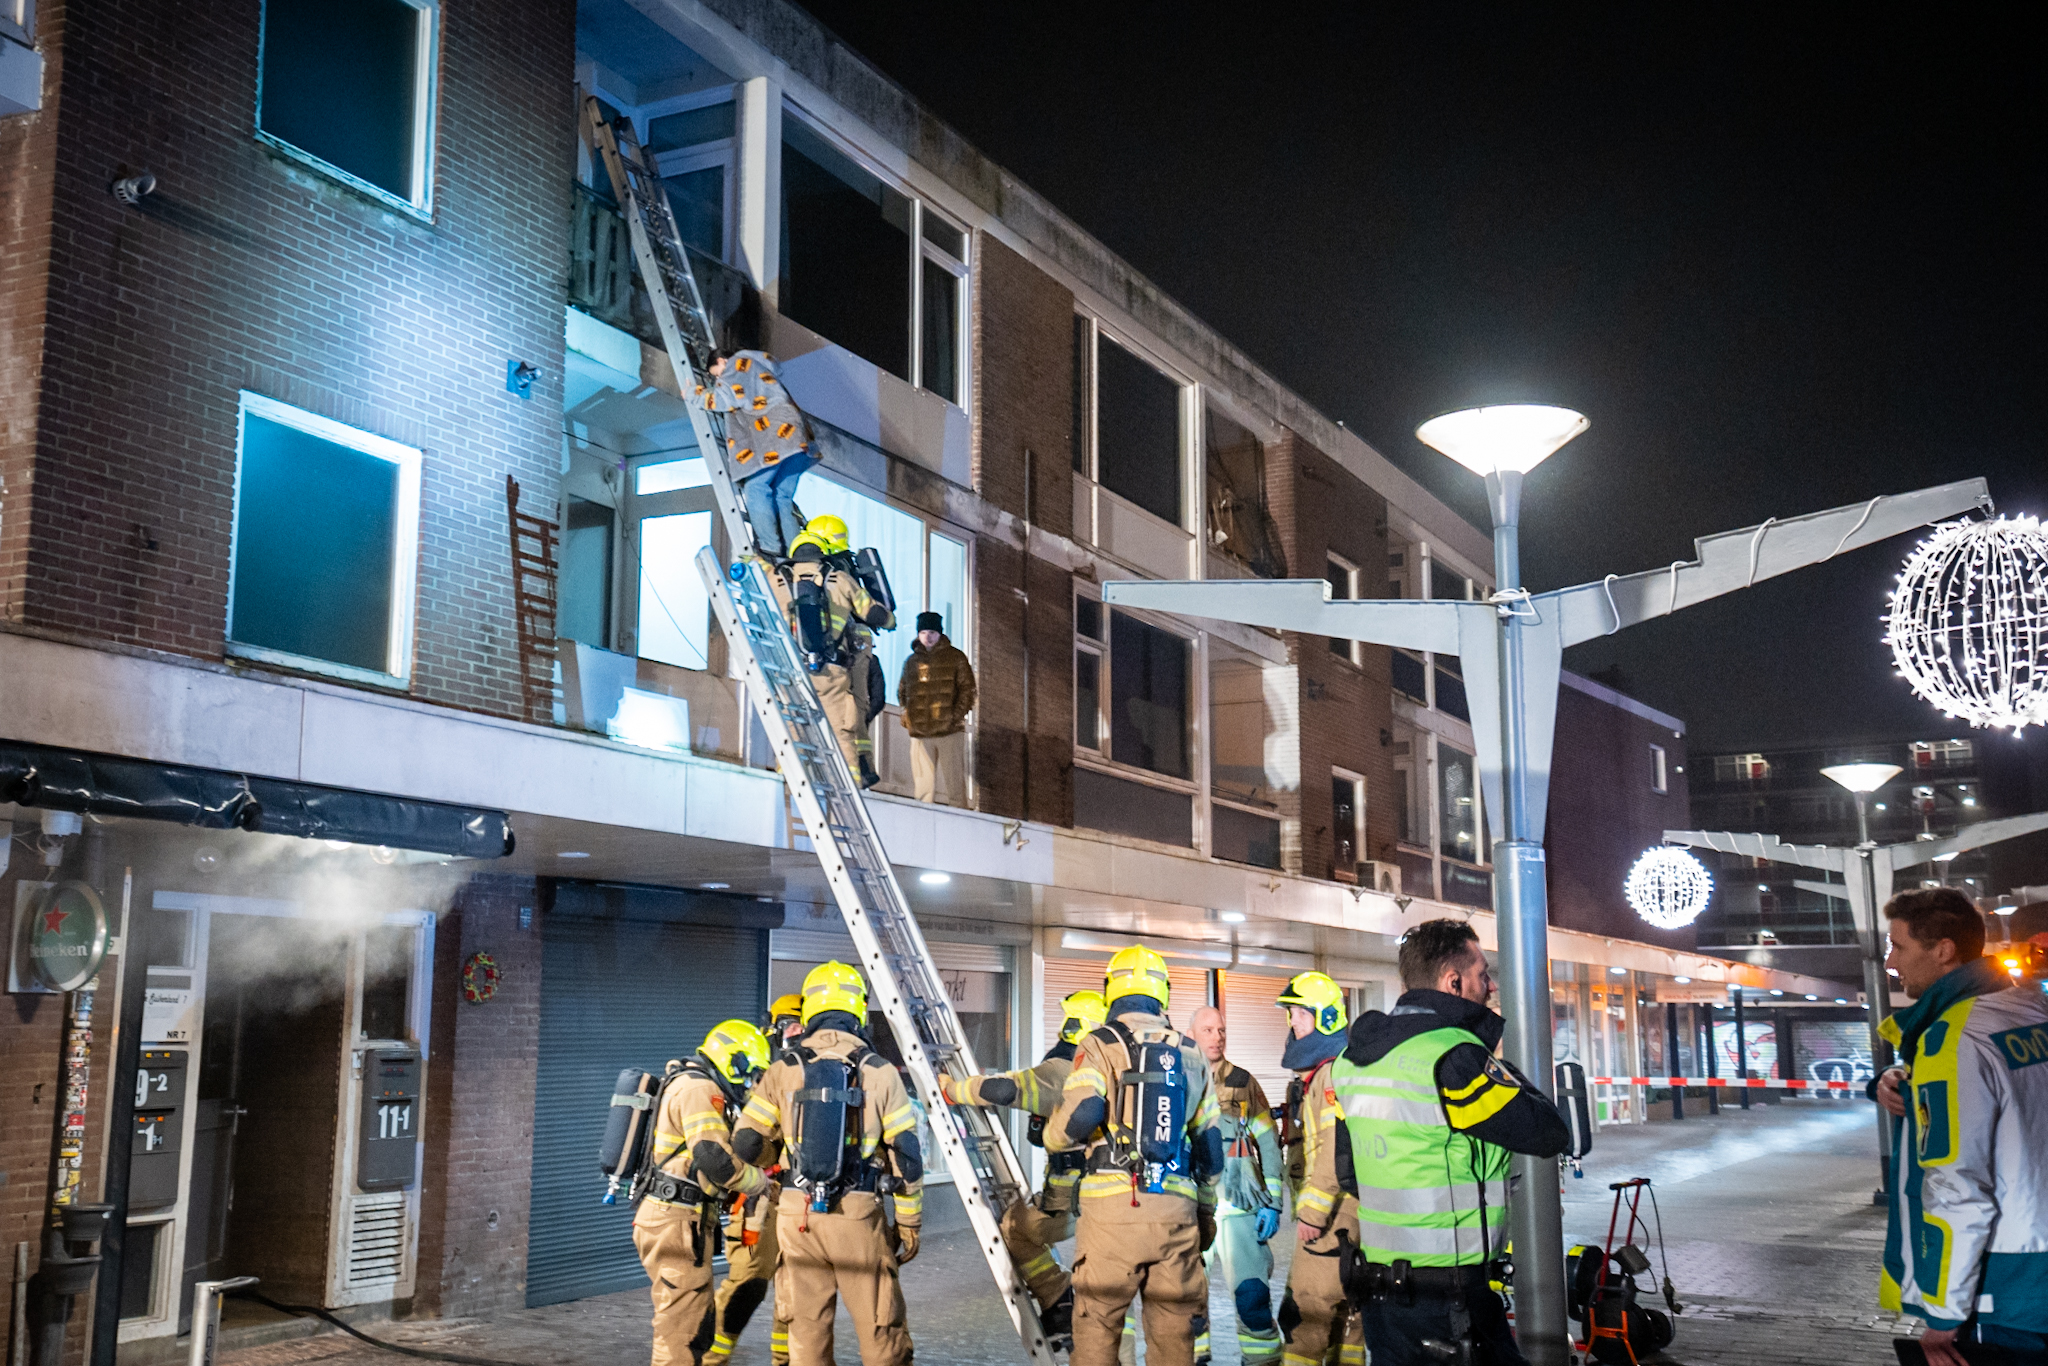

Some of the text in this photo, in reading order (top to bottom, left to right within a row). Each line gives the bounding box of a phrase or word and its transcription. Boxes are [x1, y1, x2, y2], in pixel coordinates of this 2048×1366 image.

[167, 1031, 187, 1039] NR 7
[378, 1104, 411, 1139] 11-1
[1154, 1095, 1172, 1142] BGM
